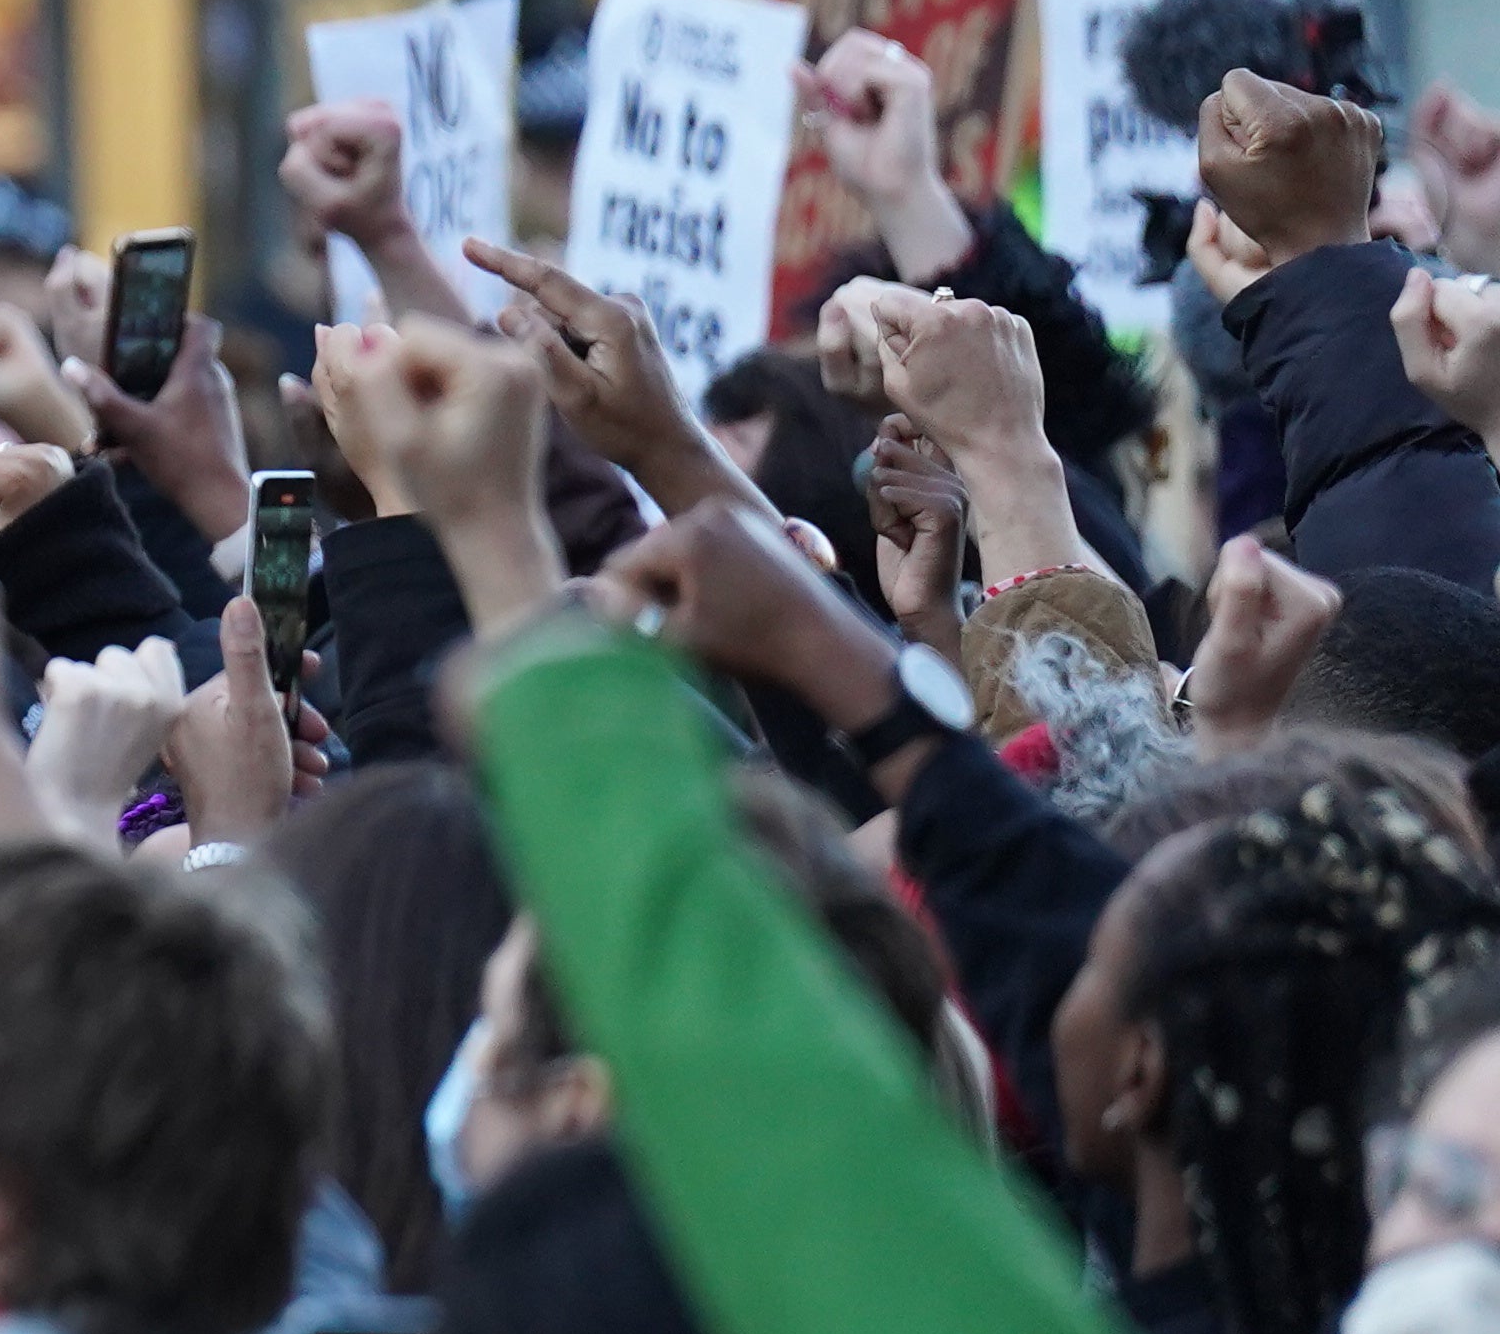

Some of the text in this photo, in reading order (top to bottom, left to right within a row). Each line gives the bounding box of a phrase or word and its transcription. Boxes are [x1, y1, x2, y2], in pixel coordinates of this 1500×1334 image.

[615, 73, 727, 173] No to
[602, 187, 726, 275] racist
